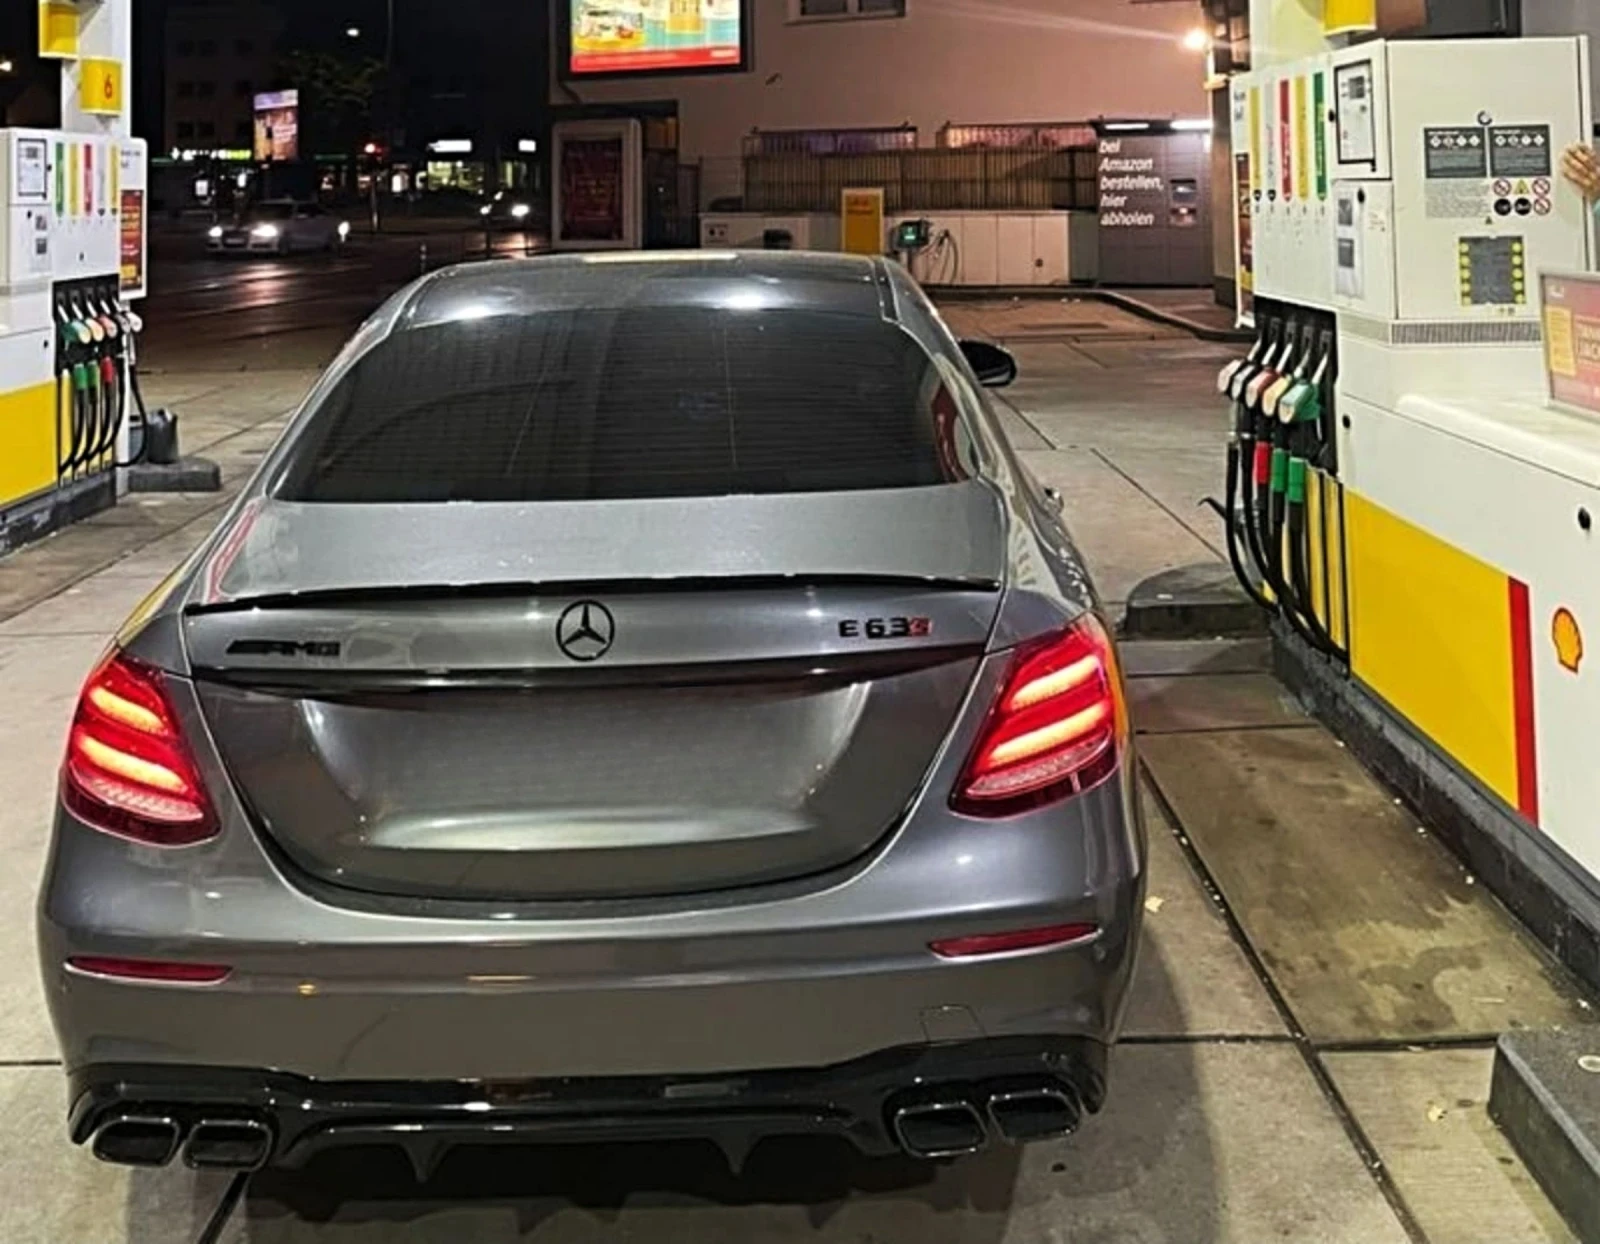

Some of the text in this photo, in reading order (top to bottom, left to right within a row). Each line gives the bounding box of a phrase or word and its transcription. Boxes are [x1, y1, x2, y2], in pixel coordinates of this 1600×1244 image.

[104, 73, 112, 99] 6
[1099, 139, 1120, 153] bei
[1099, 157, 1153, 172] Amazon
[1101, 175, 1164, 192] bestellen,
[1101, 194, 1127, 207] hier
[1101, 211, 1154, 226] abholen
